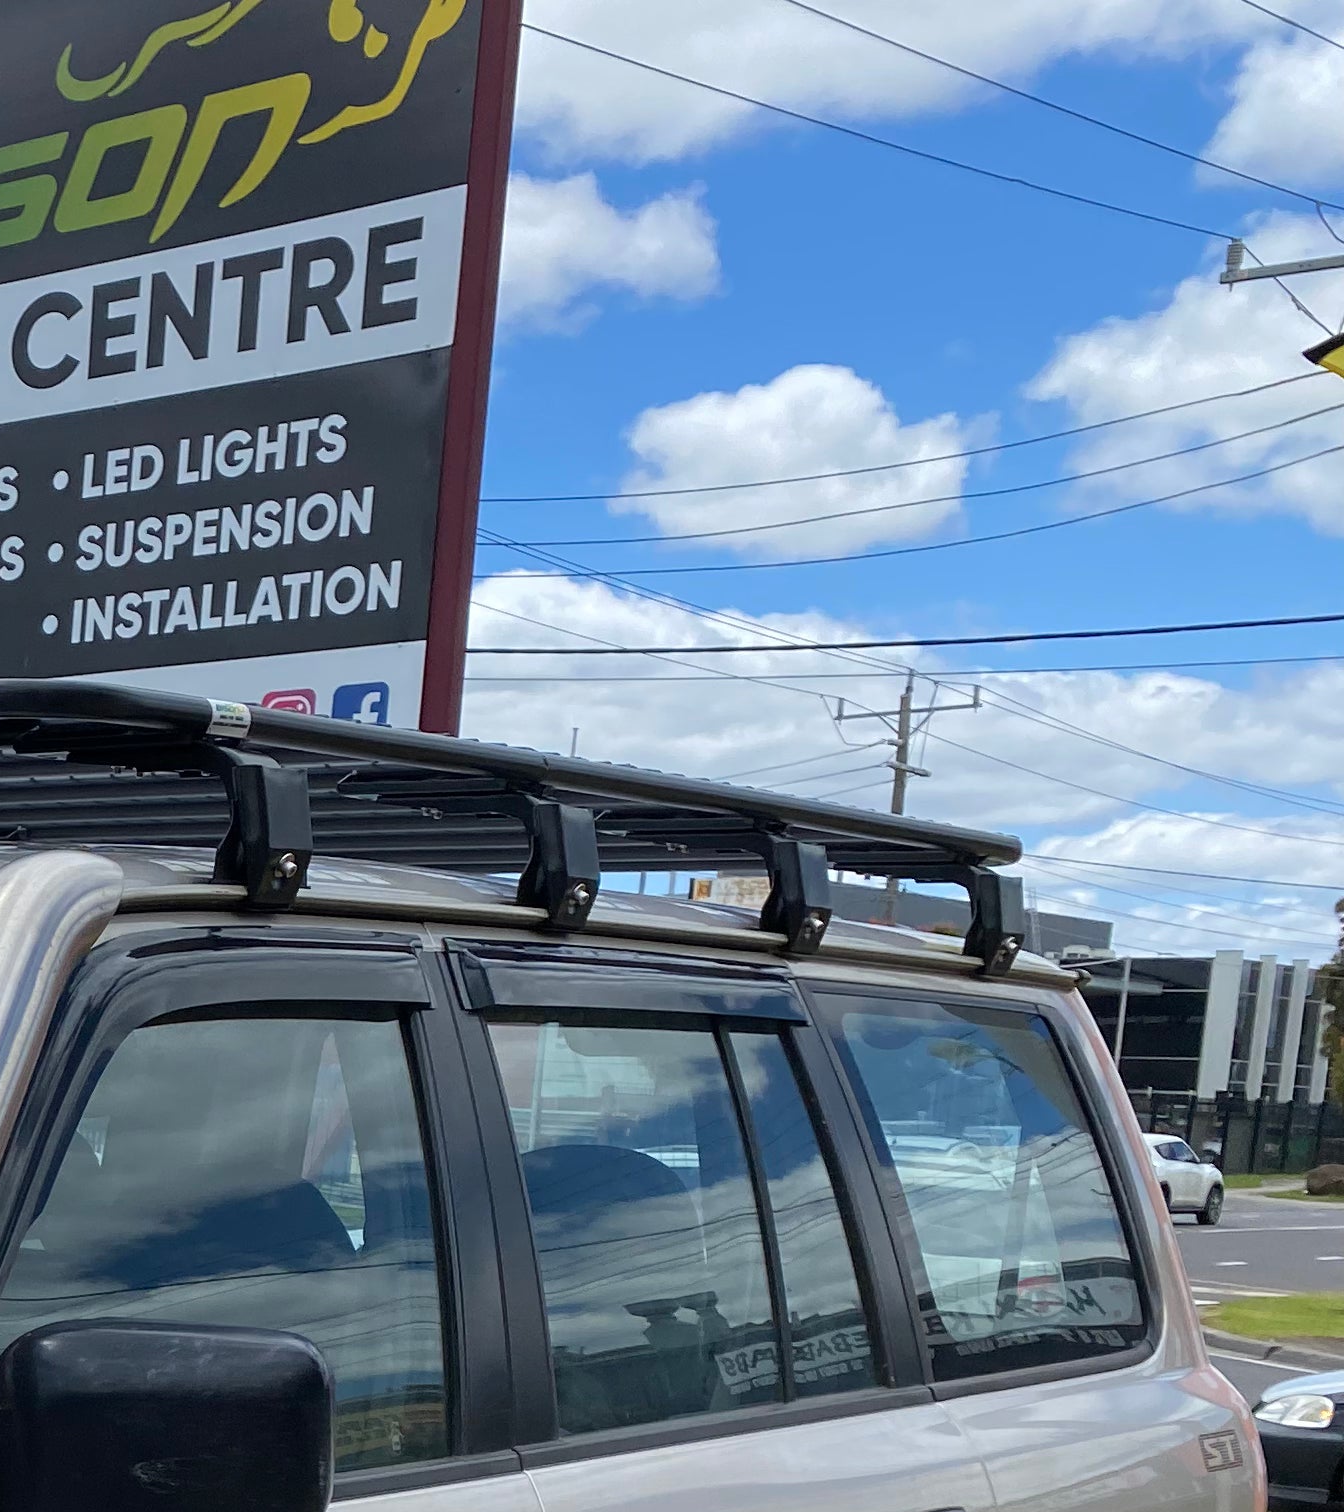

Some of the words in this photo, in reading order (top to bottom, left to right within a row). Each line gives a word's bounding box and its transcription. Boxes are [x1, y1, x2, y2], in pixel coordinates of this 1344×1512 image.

[11, 216, 425, 389] CENTRE
[81, 438, 178, 499] LED
[177, 414, 348, 485] LIGHTS
[76, 486, 375, 572] SUSPENSION
[70, 560, 403, 644] INSTALLATION
